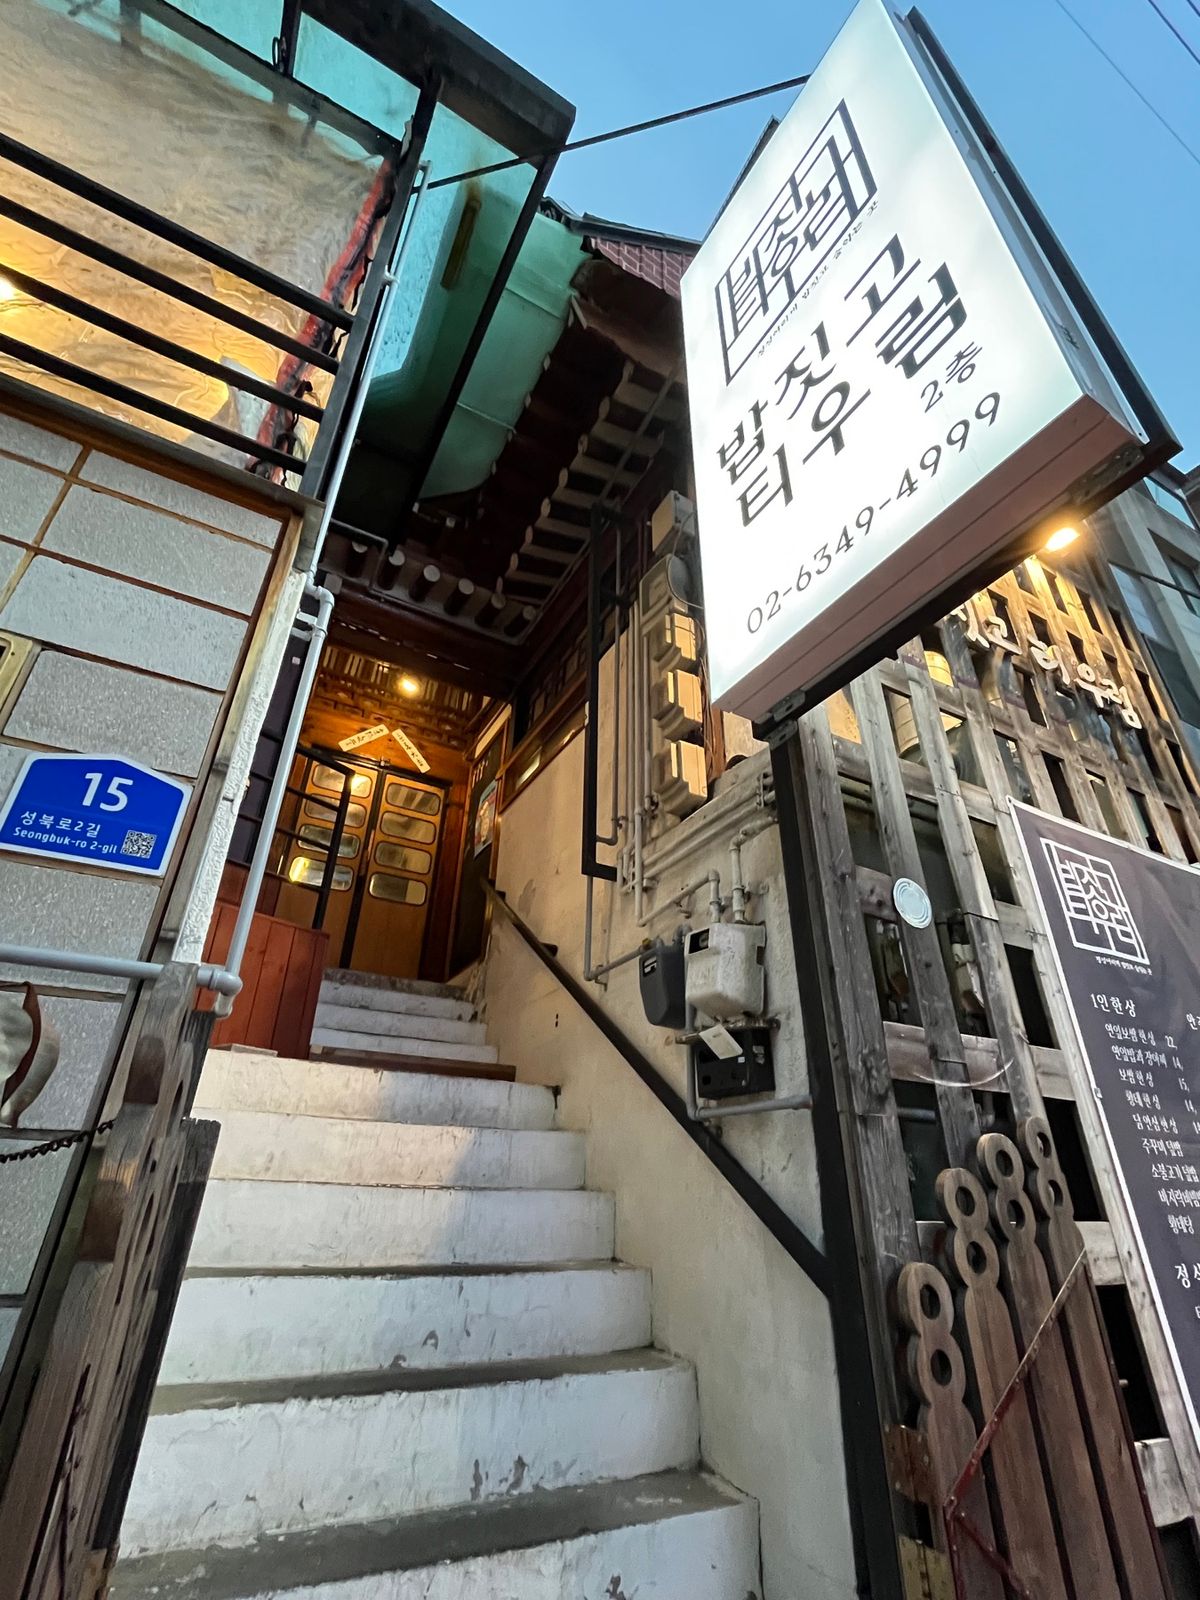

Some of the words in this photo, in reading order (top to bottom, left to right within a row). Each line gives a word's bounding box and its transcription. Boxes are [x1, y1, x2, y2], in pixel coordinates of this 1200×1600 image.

[717, 233, 921, 486] 밥짓고
[736, 261, 967, 527] 티우림
[921, 341, 983, 413] 2층
[747, 392, 1000, 634] 02-6349-4999
[21, 810, 101, 838] 성북로2길
[82, 772, 134, 812] 15
[13, 826, 87, 849] Seongbuk-ro
[90, 840, 118, 855] 2-gil
